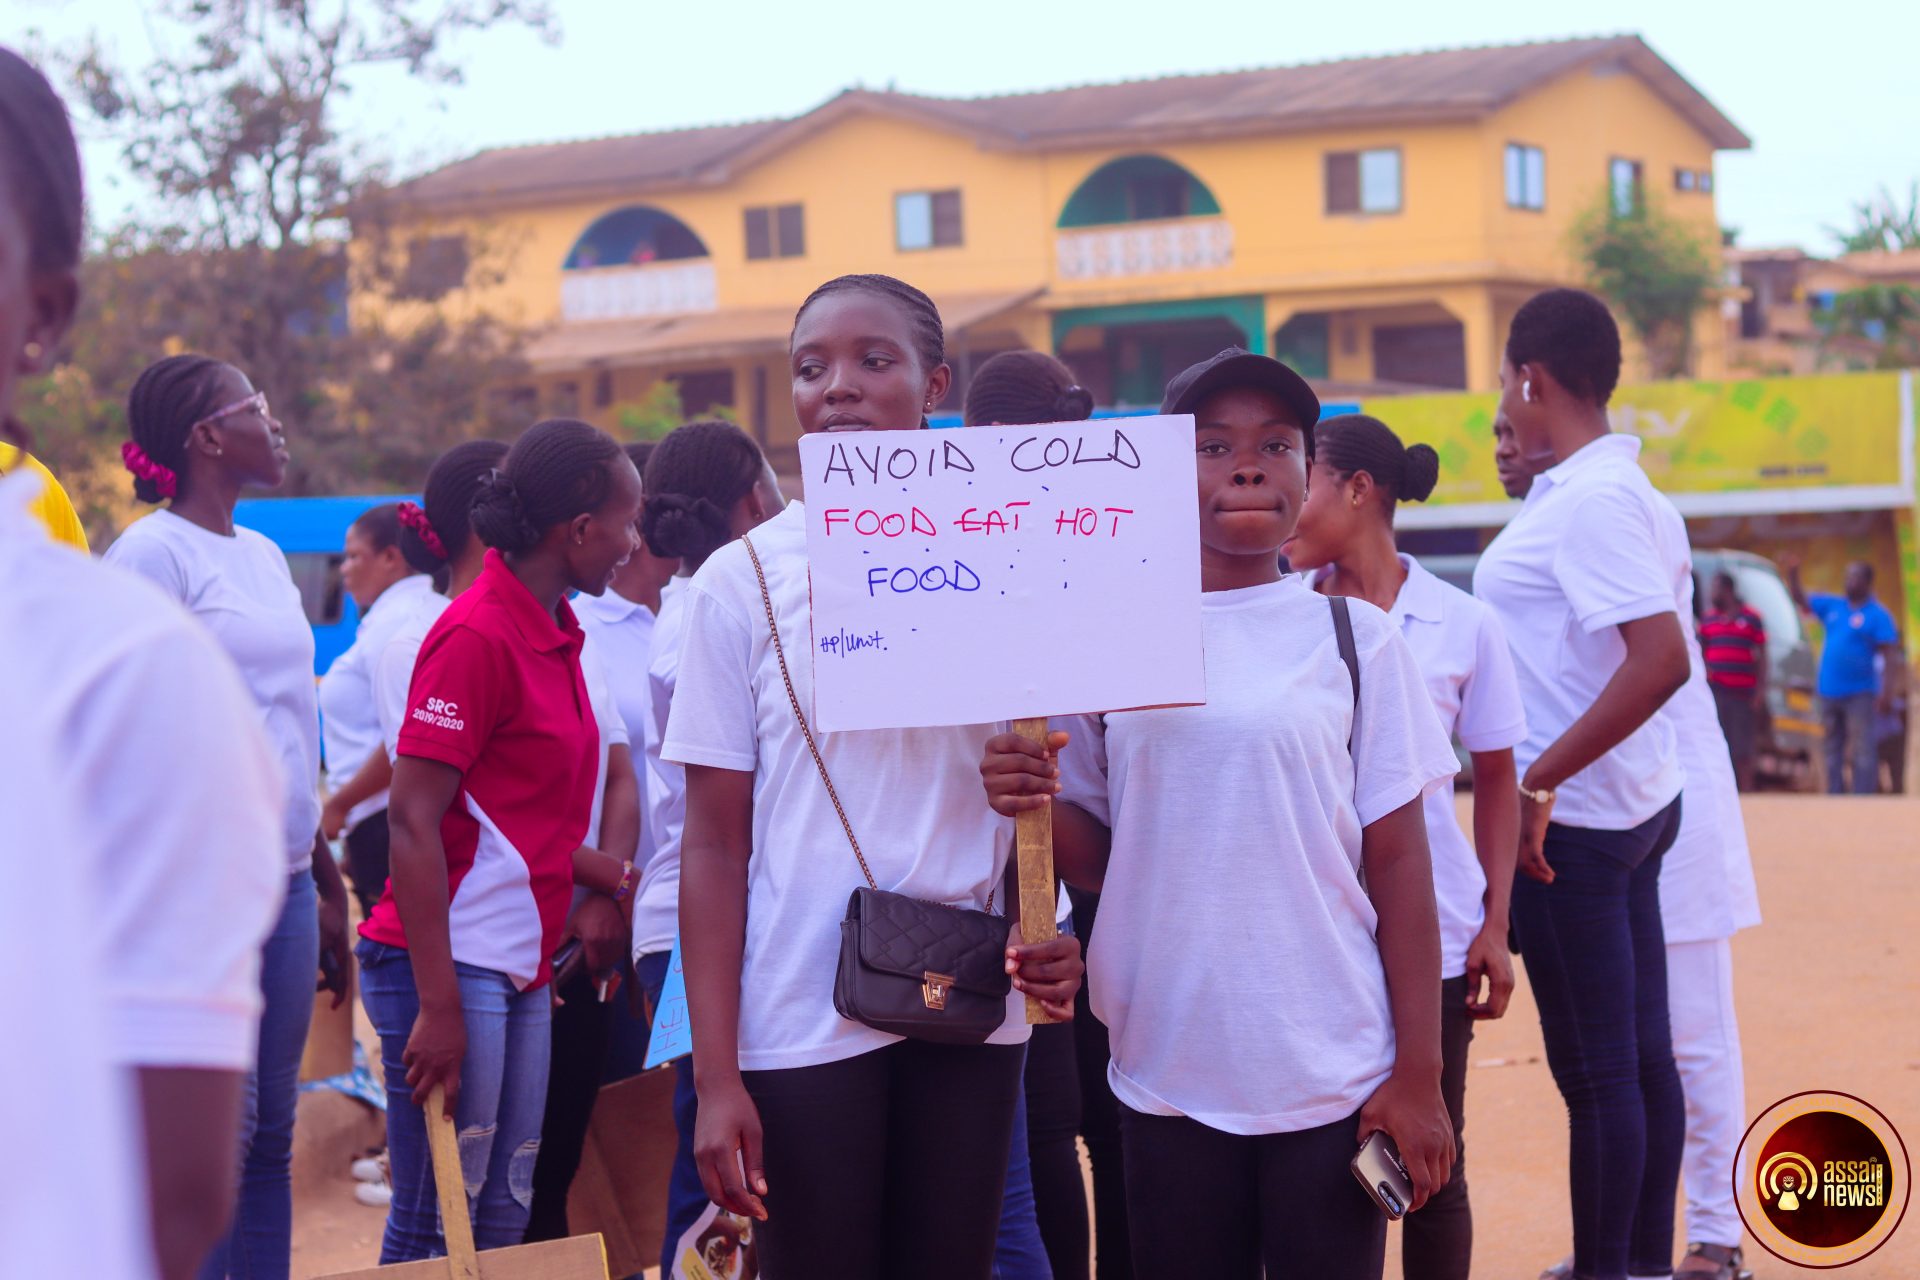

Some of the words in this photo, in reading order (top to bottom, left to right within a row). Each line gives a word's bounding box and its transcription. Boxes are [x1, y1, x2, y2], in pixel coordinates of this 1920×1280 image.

[1010, 429, 1142, 472] COLD
[824, 506, 936, 537] FOOD
[952, 501, 1031, 536] EAT
[1055, 507, 1134, 537] HOT
[867, 560, 981, 597] FOOD
[412, 708, 465, 731] 2019/2020
[426, 697, 458, 717] SRC
